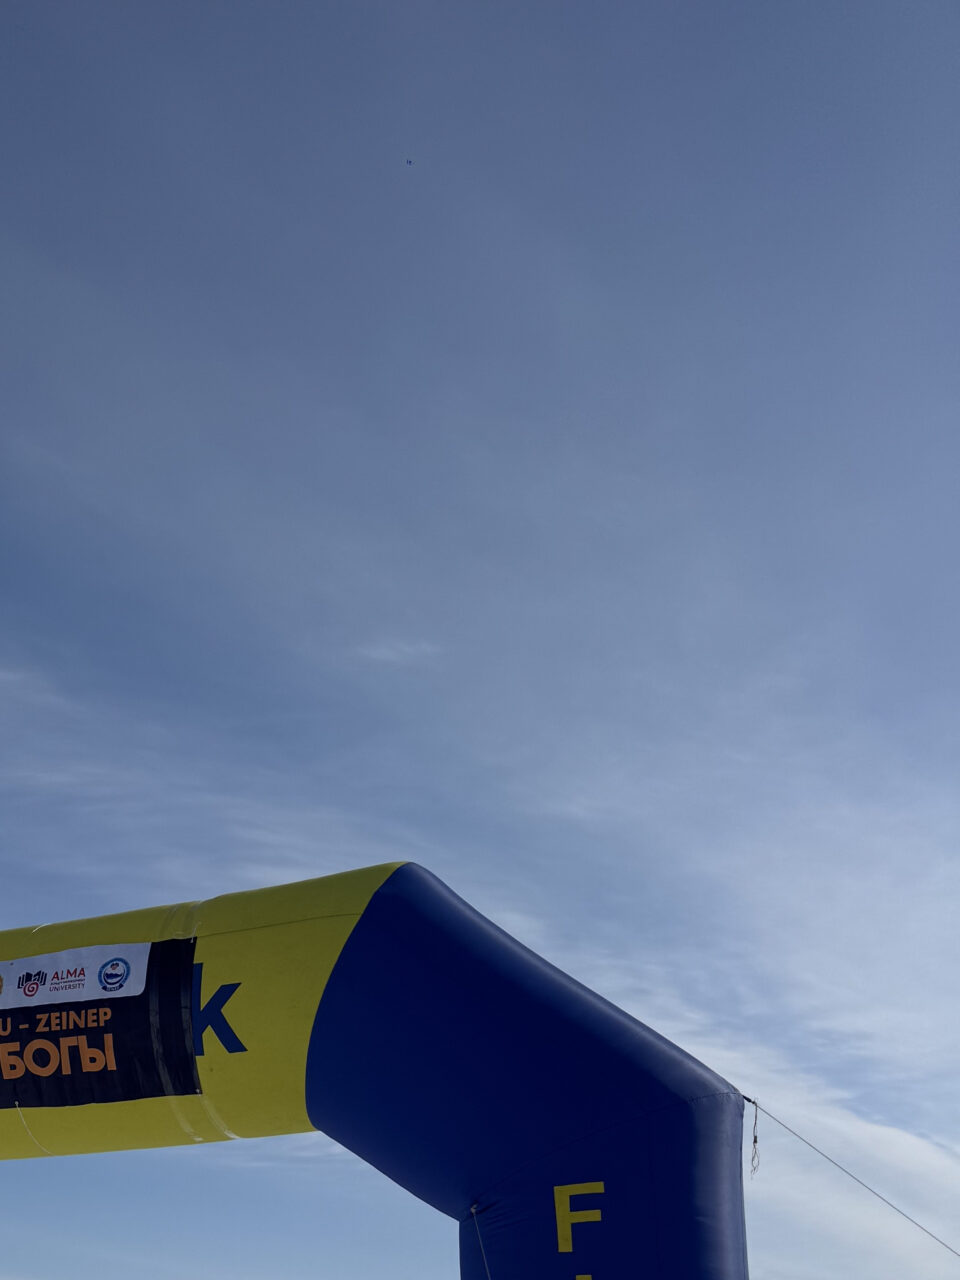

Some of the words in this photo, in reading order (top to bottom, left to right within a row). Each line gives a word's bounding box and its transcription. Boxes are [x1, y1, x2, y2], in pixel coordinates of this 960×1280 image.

[51, 967, 86, 982] ALMA
[49, 983, 85, 993] UNIVERSITY
[36, 1007, 112, 1032] ZEINEP
